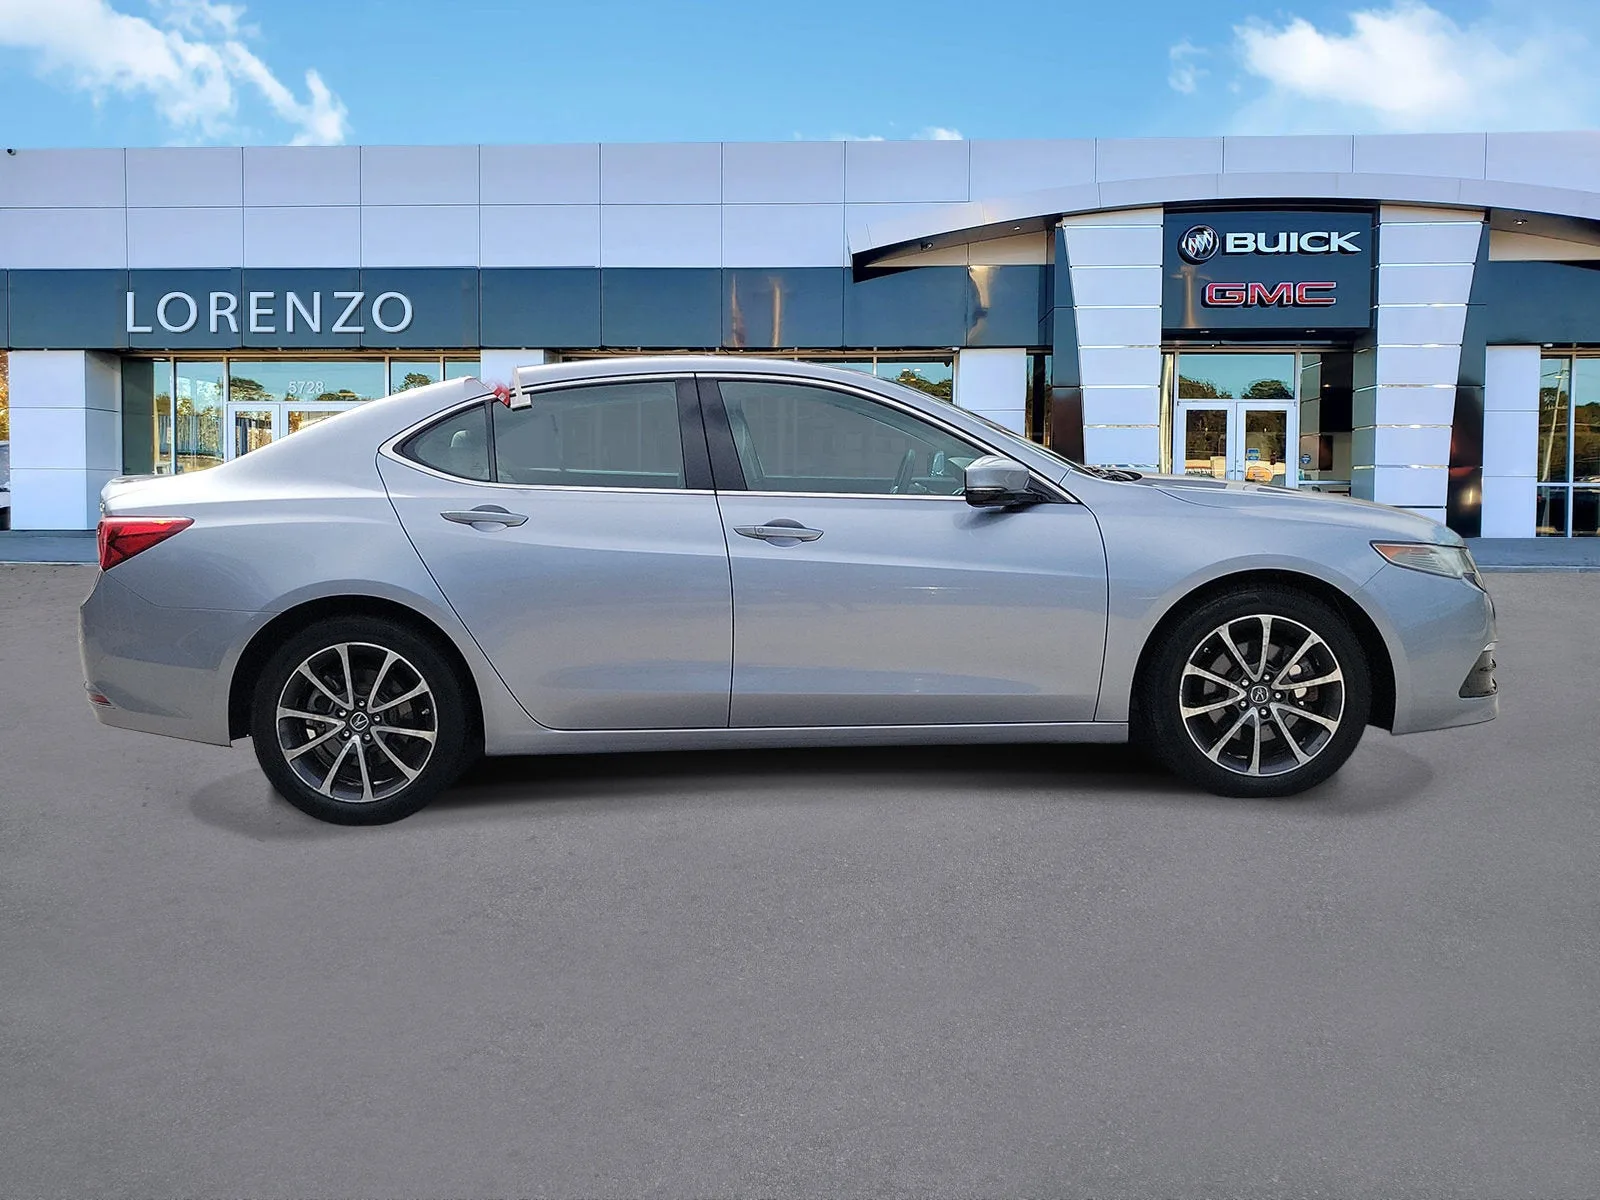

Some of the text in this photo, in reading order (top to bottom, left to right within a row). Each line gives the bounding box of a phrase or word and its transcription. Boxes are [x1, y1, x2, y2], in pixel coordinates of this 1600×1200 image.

[1225, 231, 1362, 253] BUICK
[1206, 281, 1337, 305] GMC
[126, 291, 413, 333] LORENZO
[288, 381, 325, 394] 5728
